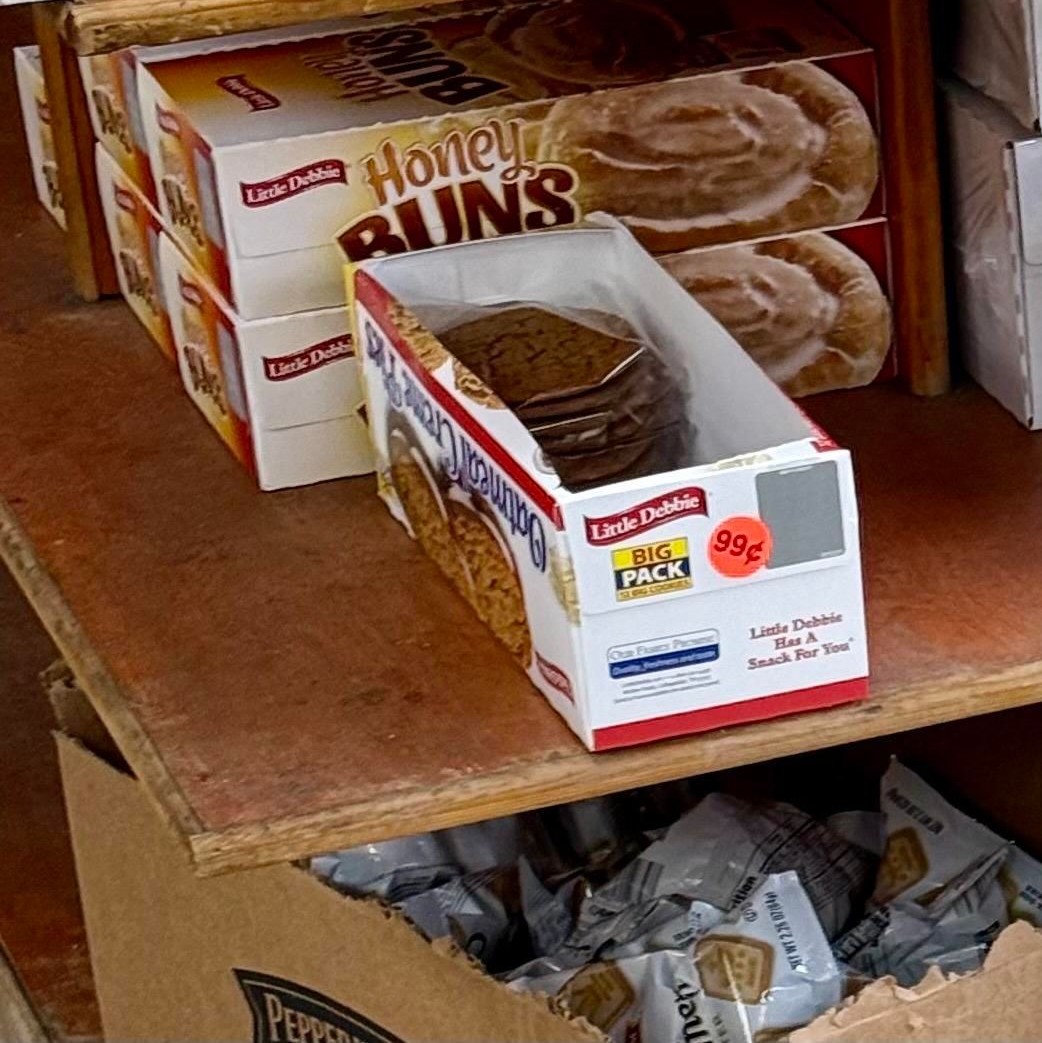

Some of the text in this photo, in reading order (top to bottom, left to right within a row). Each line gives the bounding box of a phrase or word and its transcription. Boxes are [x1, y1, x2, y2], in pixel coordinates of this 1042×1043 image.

[345, 28, 509, 106] BUNS
[362, 119, 539, 206] Honey
[245, 163, 342, 206] Little Debbie
[335, 166, 578, 263] BUNS
[460, 435, 547, 573] Oatmeal
[590, 493, 701, 541] Little Debbie
[631, 543, 673, 566] BIG
[713, 529, 766, 567] 99¢
[621, 560, 686, 588] PACK
[749, 611, 844, 641] Little Debbie
[774, 631, 819, 651] Has A
[747, 639, 852, 671] Snack For You
